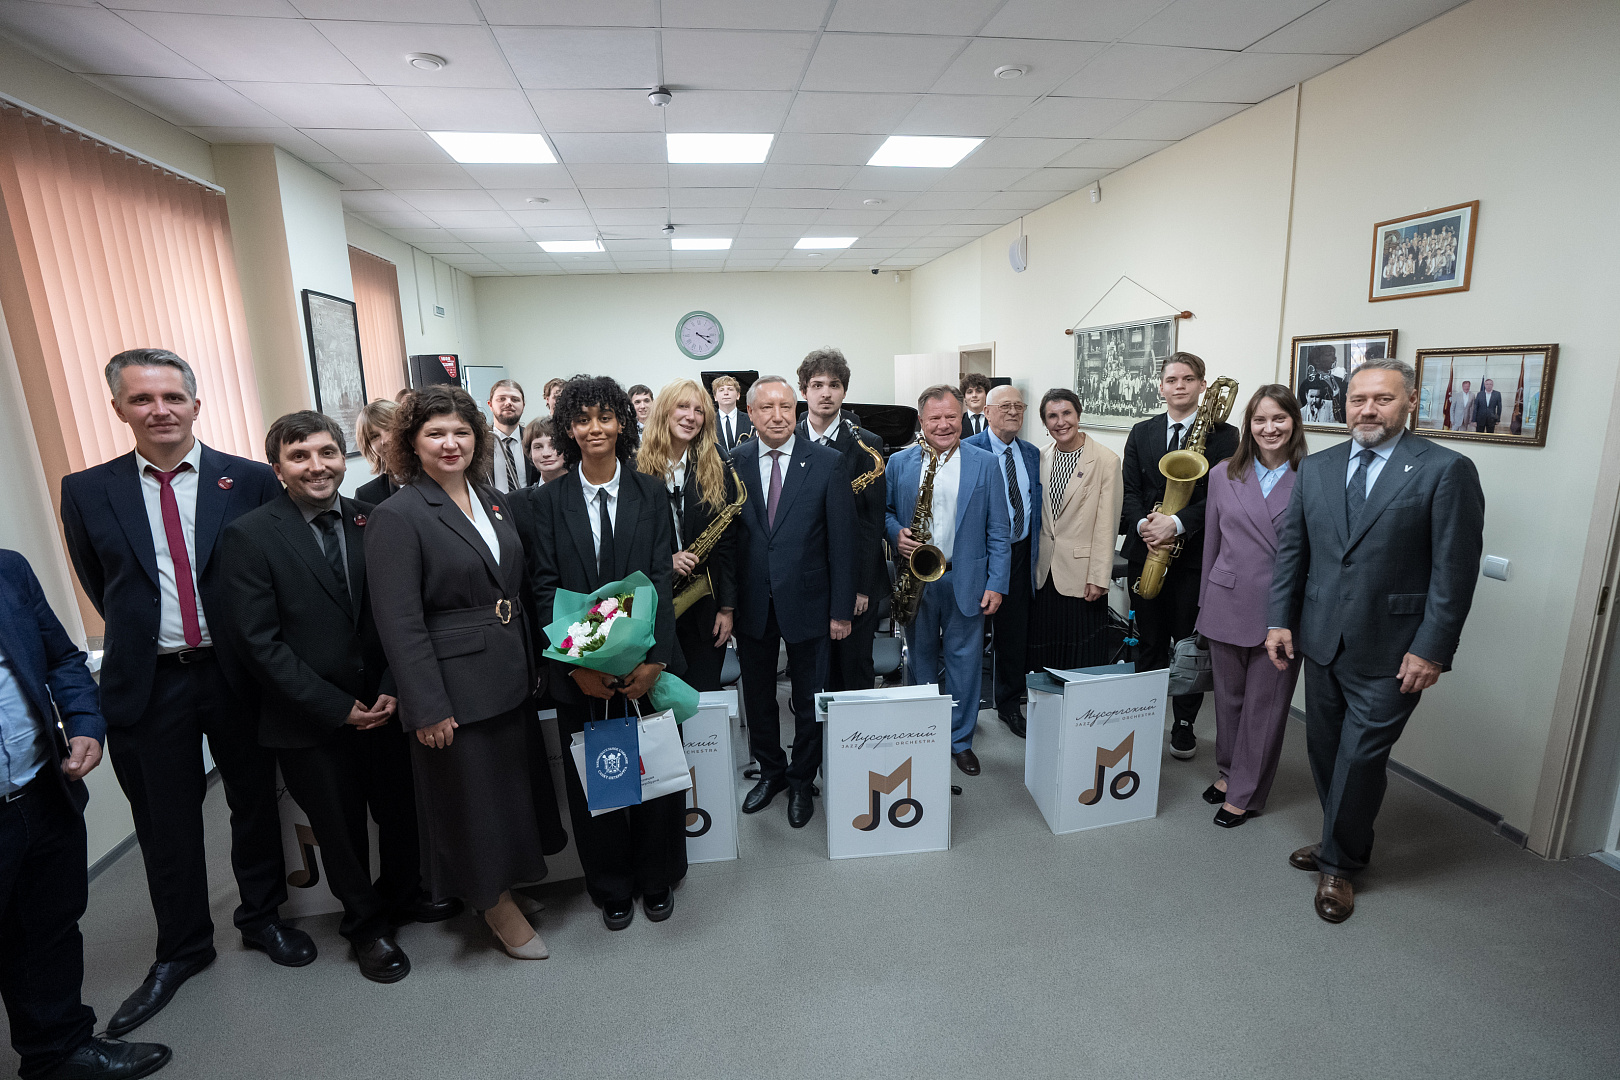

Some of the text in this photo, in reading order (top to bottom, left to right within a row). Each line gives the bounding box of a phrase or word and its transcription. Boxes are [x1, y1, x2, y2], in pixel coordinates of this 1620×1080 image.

[1075, 698, 1157, 728] Мусоргский
[1121, 711, 1155, 721] ORCHESTRA
[841, 724, 937, 750] Мусоргский
